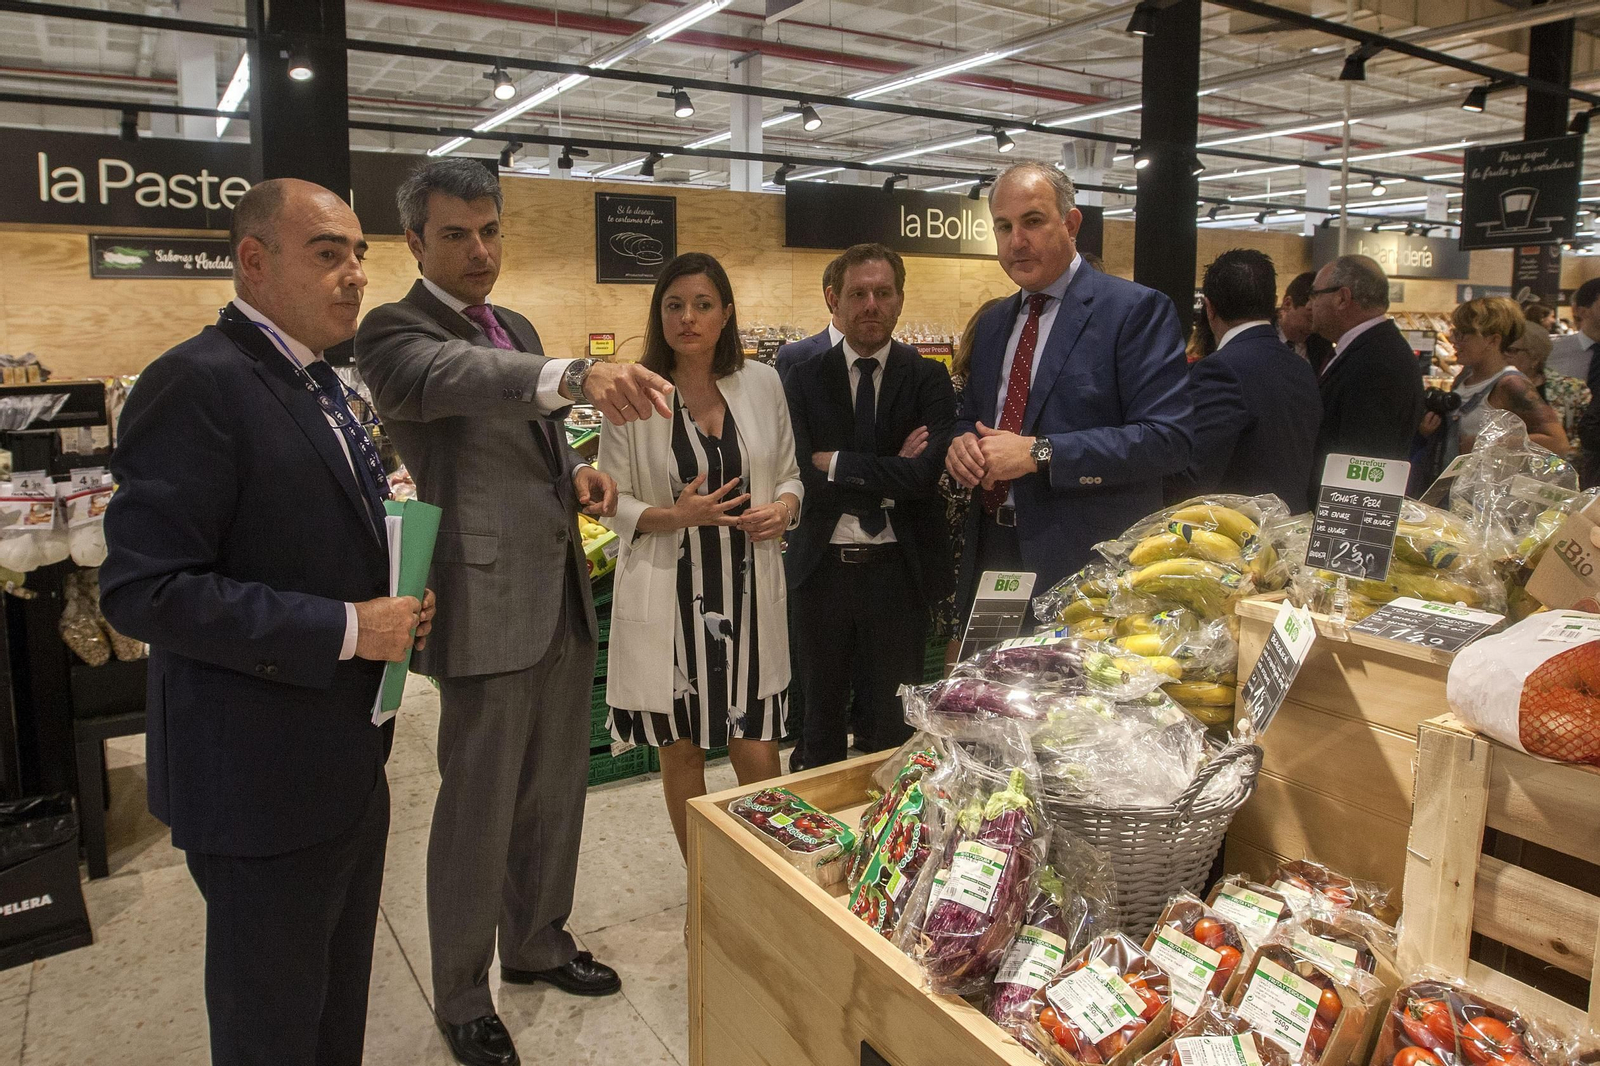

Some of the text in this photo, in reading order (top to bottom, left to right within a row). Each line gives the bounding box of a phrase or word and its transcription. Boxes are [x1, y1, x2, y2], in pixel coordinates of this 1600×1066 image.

[37, 151, 85, 204] la
[901, 205, 921, 238] la
[155, 249, 193, 262] Sabores
[1350, 457, 1387, 468] Carrefour
[1346, 464, 1384, 483] BIO
[1330, 492, 1382, 508] TOMATE PERA
[1564, 538, 1594, 577] Bio
[994, 579, 1020, 592] BIO
[1284, 616, 1300, 643] BIO
[1167, 942, 1180, 952] FRUTA
[1184, 951, 1204, 965] VERDURA
[1181, 940, 1198, 953] BIO
[1269, 976, 1282, 987] FRUTA
[1287, 986, 1307, 1002] VERDURA
[1282, 972, 1299, 989] BIO
[1274, 1017, 1290, 1031] 250g
